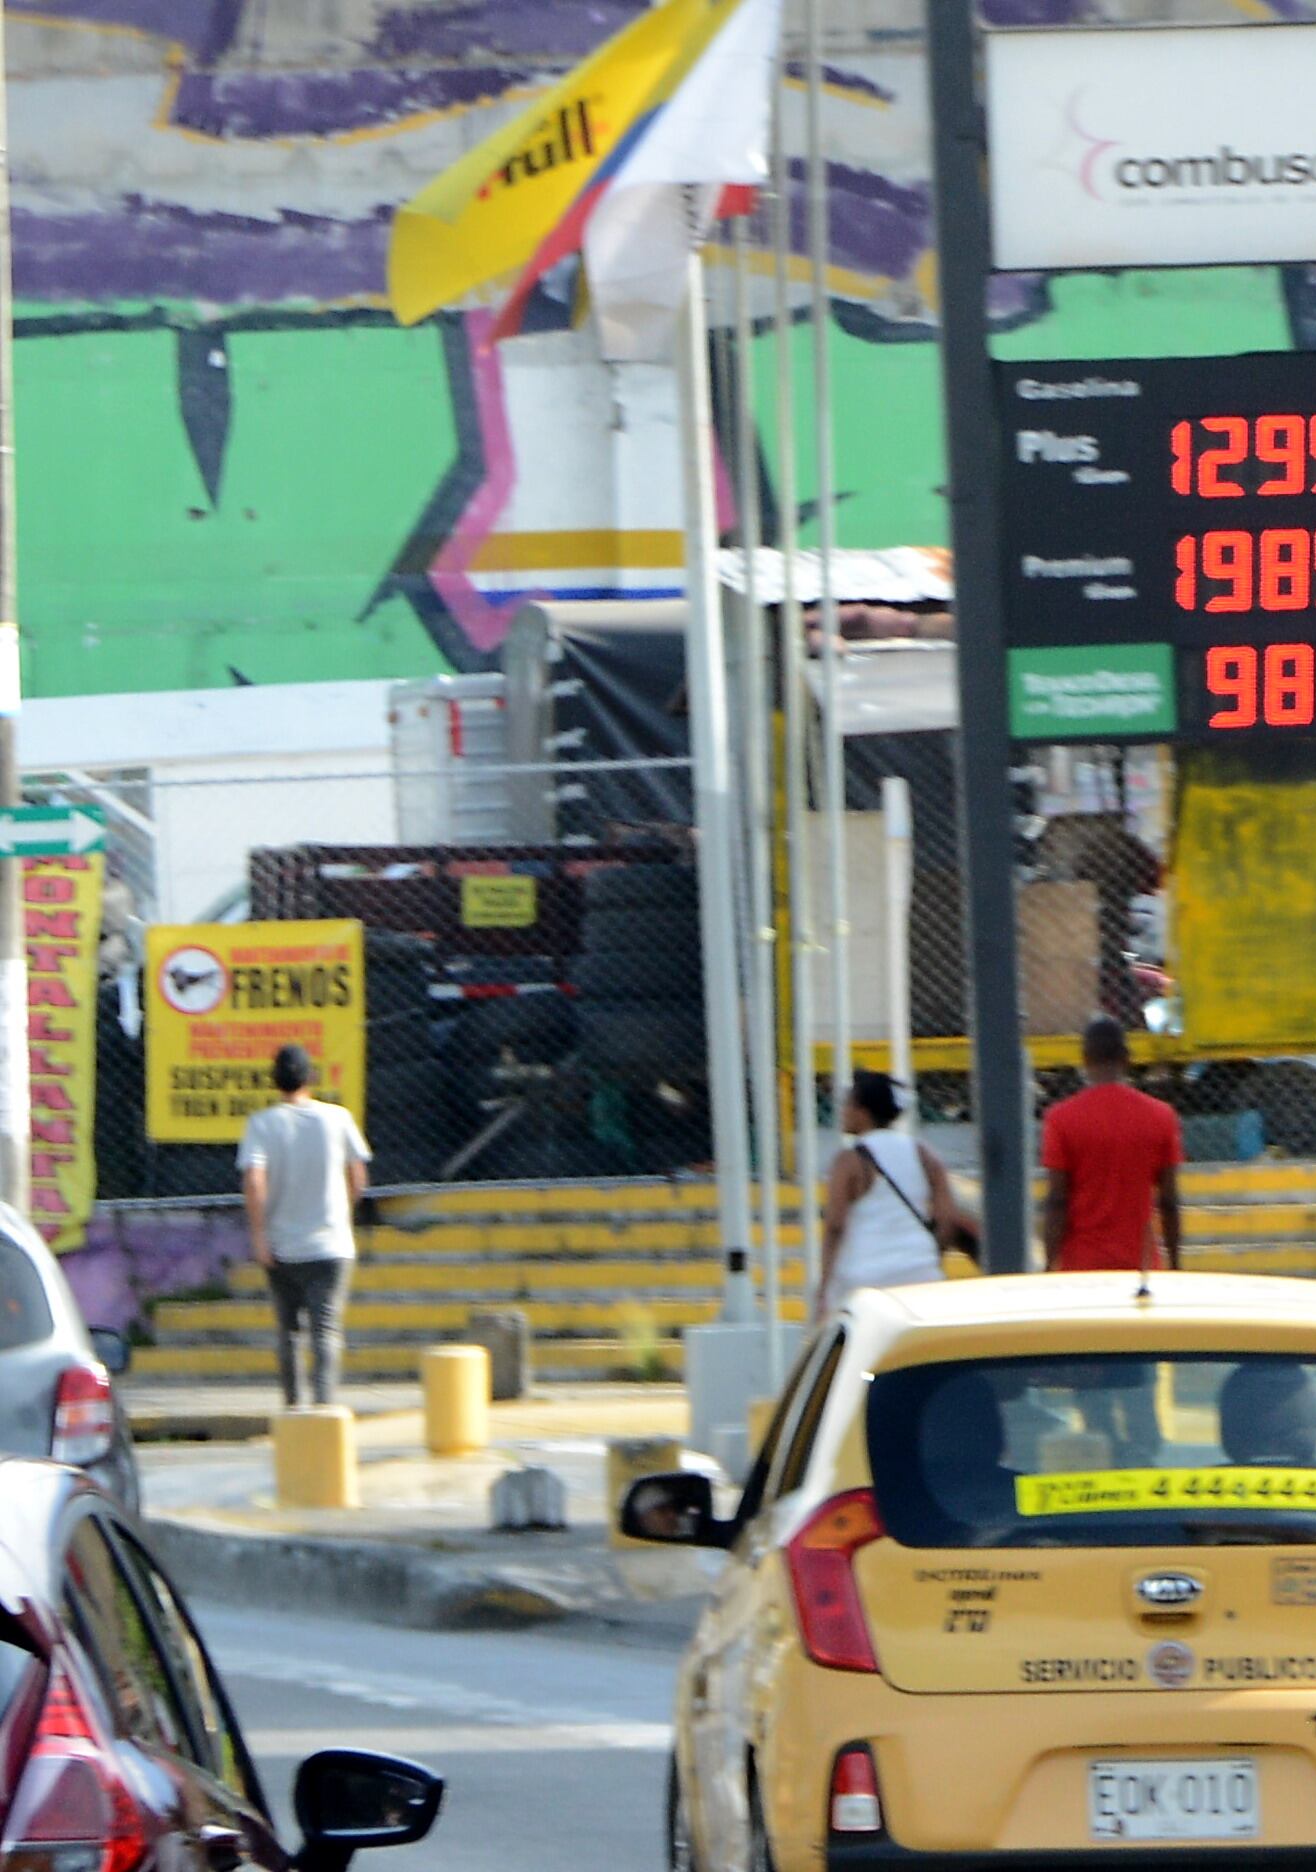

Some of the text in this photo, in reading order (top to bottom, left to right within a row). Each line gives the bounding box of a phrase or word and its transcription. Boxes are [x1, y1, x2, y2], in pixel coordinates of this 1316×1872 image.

[230, 963, 351, 1010] FRENOS
[22, 856, 88, 1242] ONTALLANTA
[1020, 1657, 1138, 1683] SERVICIO
